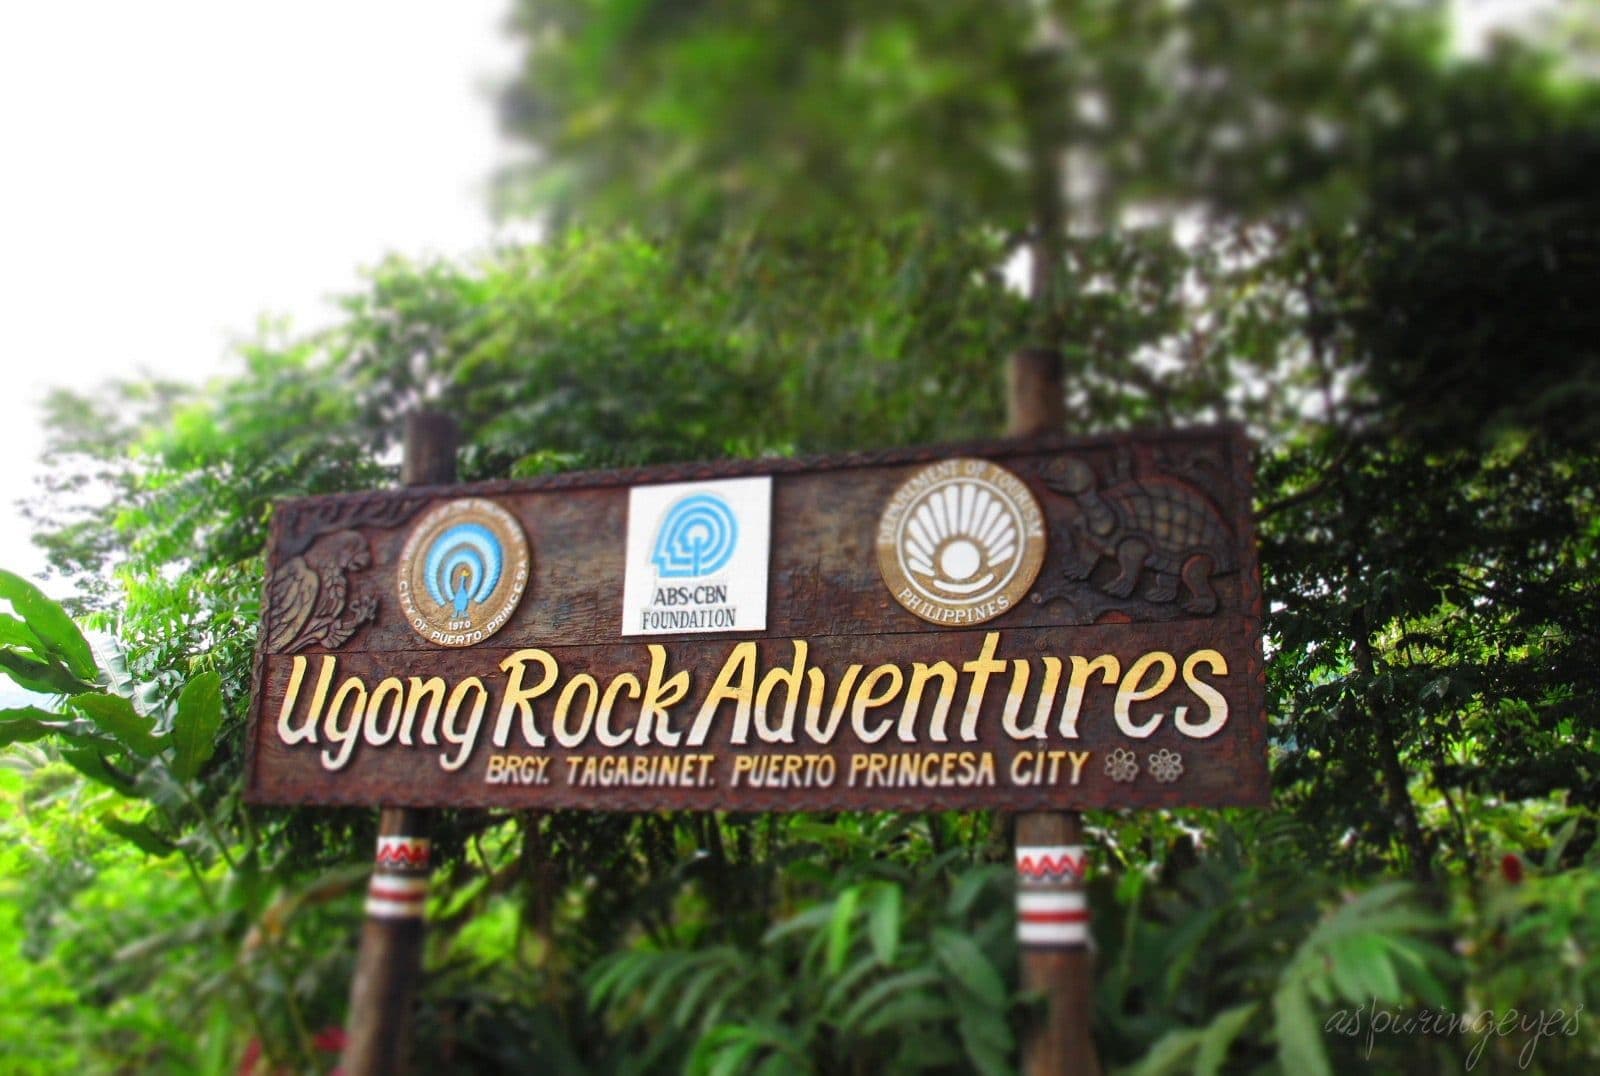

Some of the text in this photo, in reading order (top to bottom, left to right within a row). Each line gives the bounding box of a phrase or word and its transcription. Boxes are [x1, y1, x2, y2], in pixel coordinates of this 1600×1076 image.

[399, 560, 529, 645] CITY OF PUERTO PRINCESA
[642, 608, 737, 630] FOUNDATION
[898, 587, 1011, 624] PHILIPPINES
[448, 621, 471, 631] 1970
[276, 631, 1229, 772] Ugong Rock Adventures
[485, 755, 550, 785] BRGY.
[730, 752, 837, 788] PUERTO
[847, 751, 996, 788] PRINCESA
